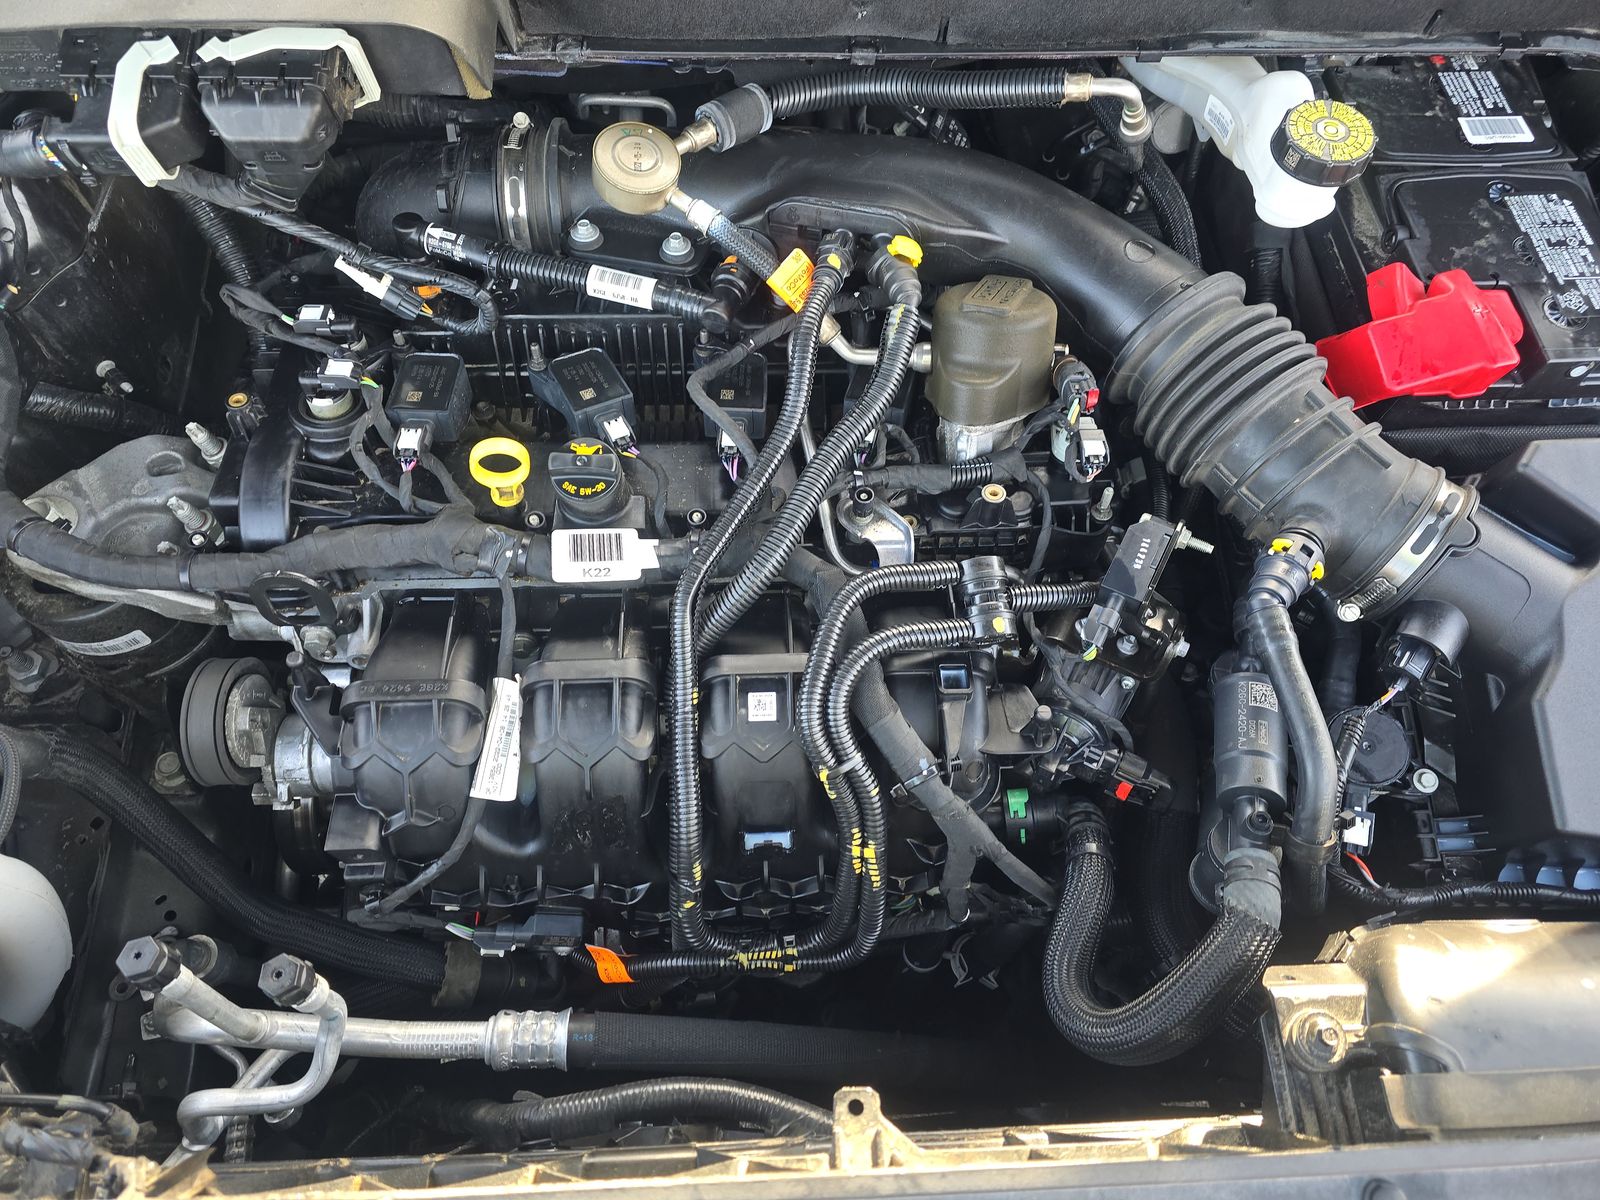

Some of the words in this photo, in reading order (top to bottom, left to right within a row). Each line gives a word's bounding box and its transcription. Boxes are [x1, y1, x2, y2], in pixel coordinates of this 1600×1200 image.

[786, 265, 810, 291] FoMoCo
[562, 481, 577, 494] SAE
[579, 481, 606, 496] 5W-30
[582, 567, 611, 578] K22
